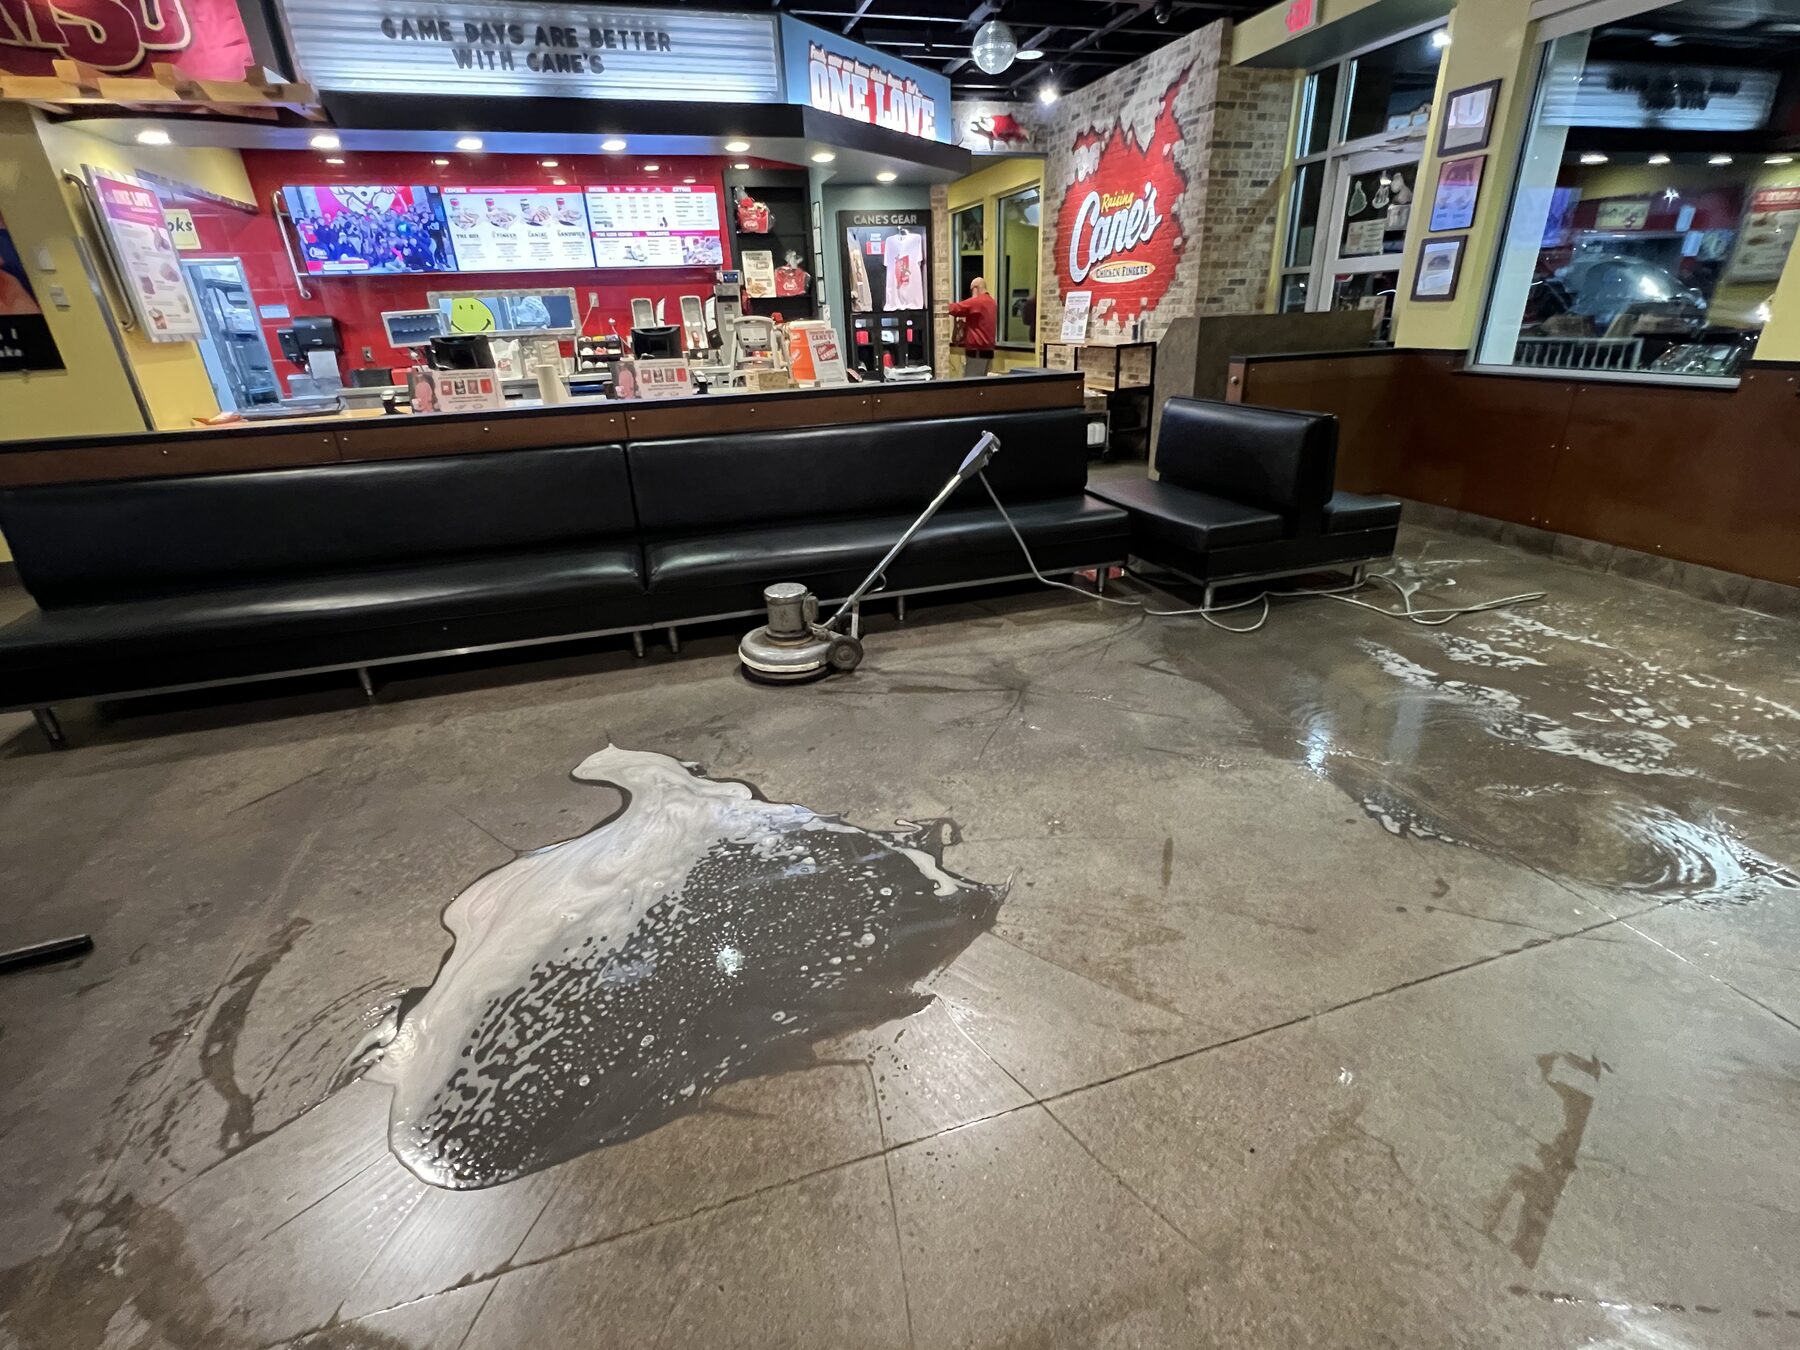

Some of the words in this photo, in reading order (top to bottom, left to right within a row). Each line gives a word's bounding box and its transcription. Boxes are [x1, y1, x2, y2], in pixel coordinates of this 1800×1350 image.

[380, 17, 453, 41] GAME
[463, 22, 525, 45] DAYS
[535, 26, 579, 48] ARE
[589, 29, 672, 52] BETTER
[452, 49, 515, 71] WITH
[526, 53, 606, 74] CANE'S
[810, 60, 870, 124] ONE
[873, 81, 936, 141] LOVE
[1101, 190, 1135, 213] Raising
[853, 215, 889, 225] CANE'S
[890, 215, 917, 225] GEAR
[1070, 181, 1163, 283] Cane's
[1122, 265, 1148, 277] FINGERS
